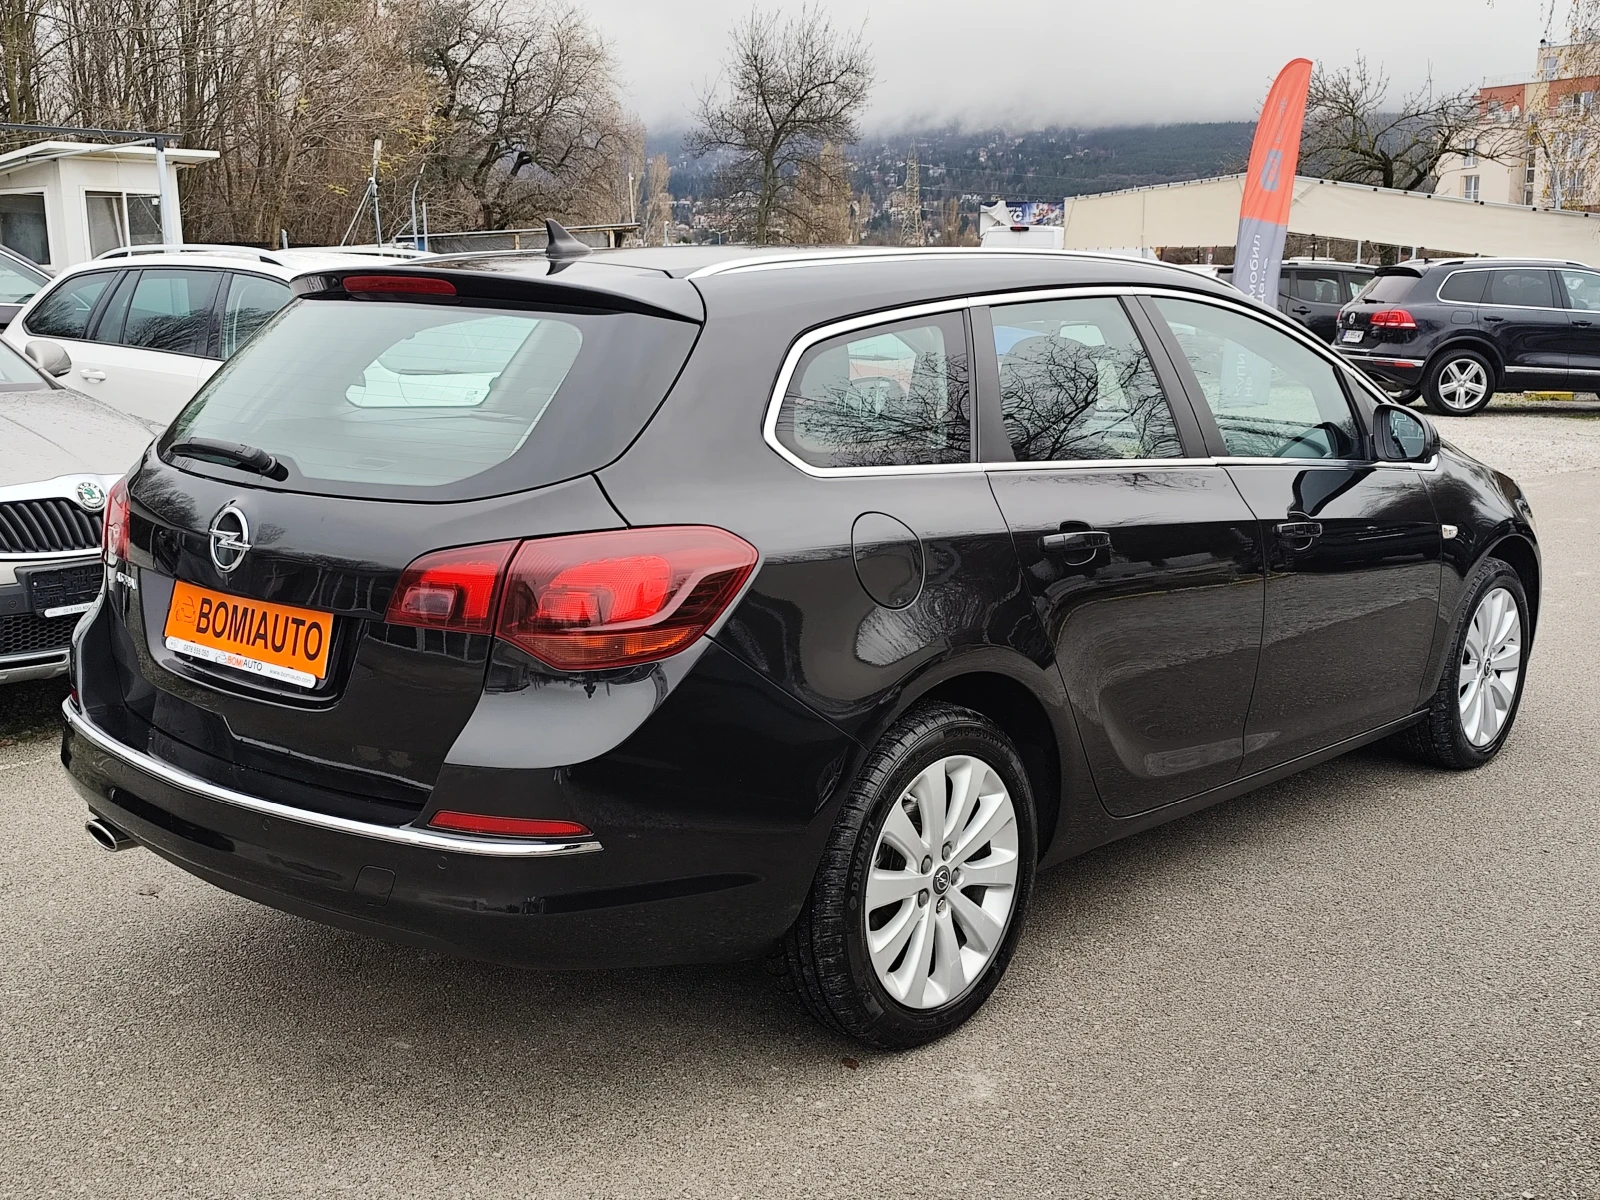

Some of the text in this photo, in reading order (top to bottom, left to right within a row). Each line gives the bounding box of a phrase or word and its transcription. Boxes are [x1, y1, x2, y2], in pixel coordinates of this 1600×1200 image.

[196, 597, 323, 661] BOMIAUTO
[227, 656, 263, 671] BOMIAUTO
[851, 820, 875, 891] DAVANTI
